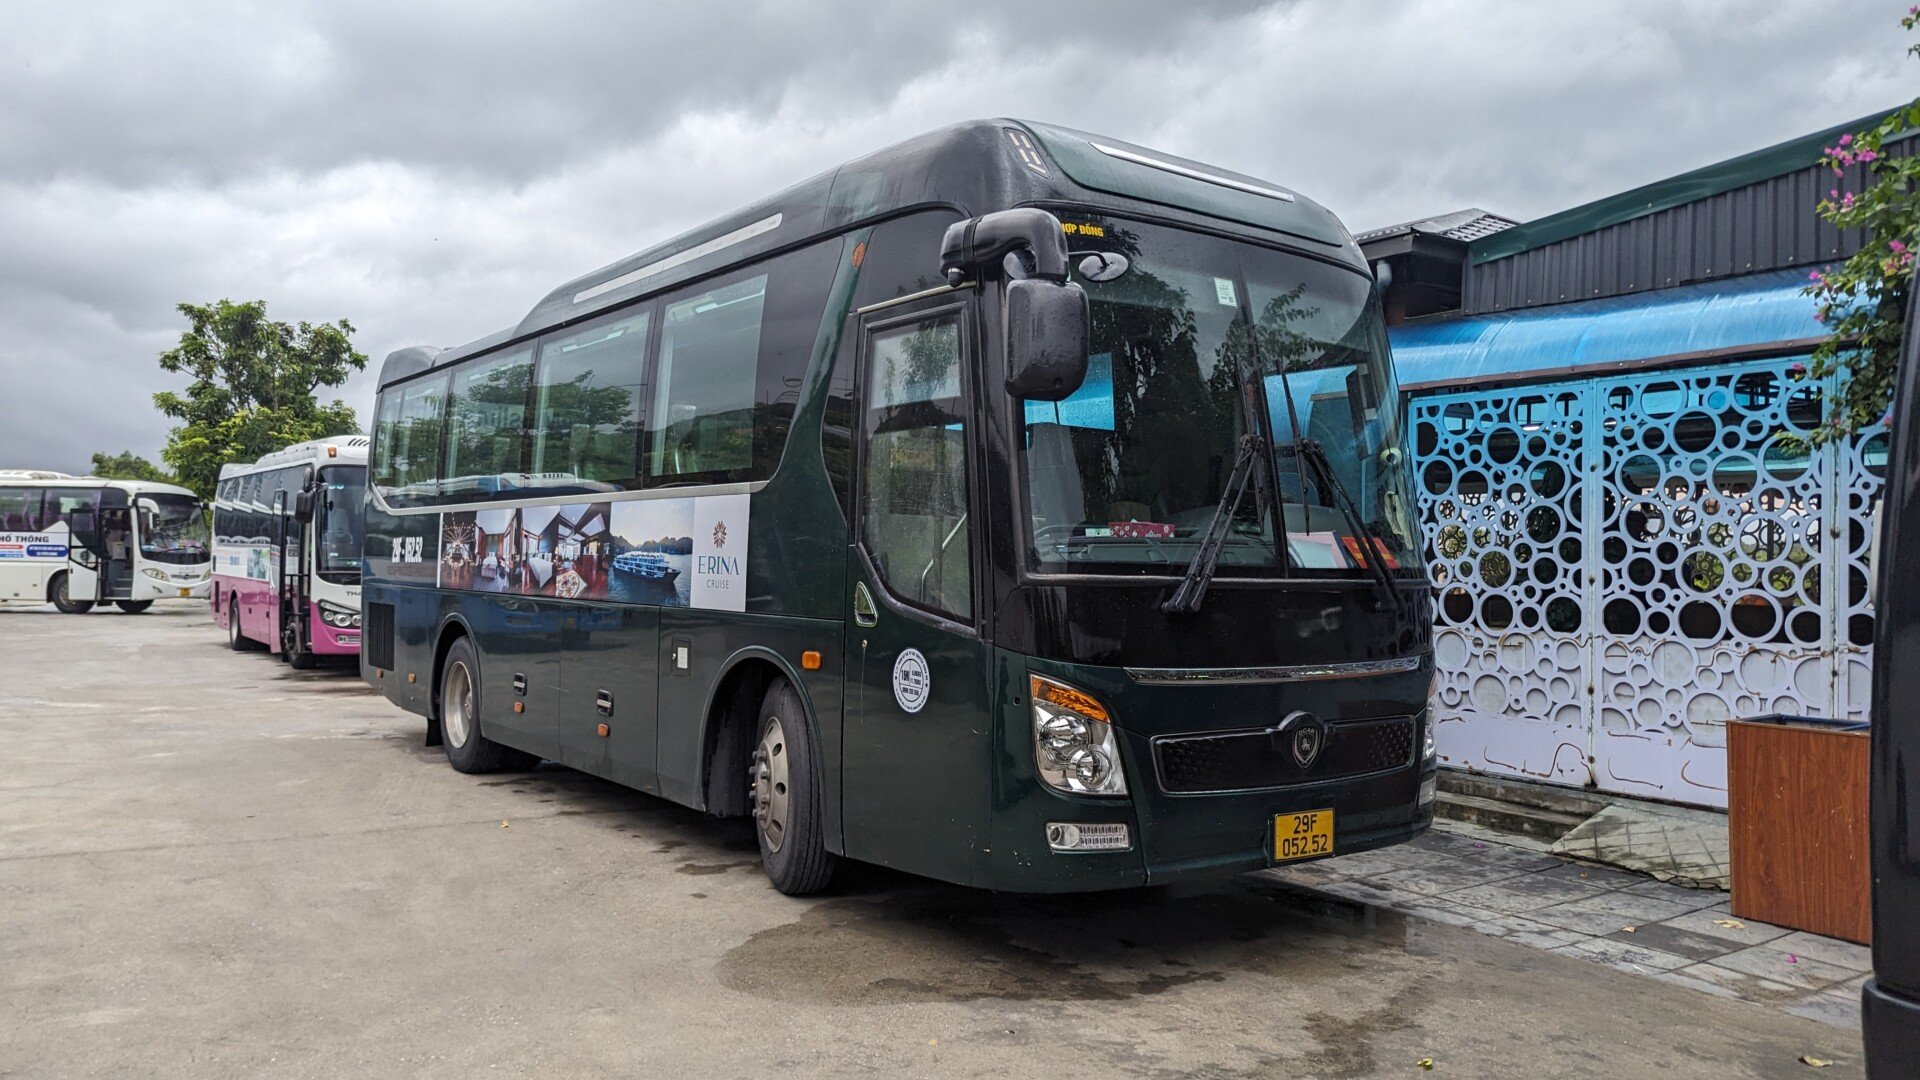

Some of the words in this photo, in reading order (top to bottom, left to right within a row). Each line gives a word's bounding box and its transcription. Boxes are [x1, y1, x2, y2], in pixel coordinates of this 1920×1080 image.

[15, 535, 49, 543] THÔNG
[698, 556, 739, 576] ERINA
[706, 579, 730, 590] CRUISE
[1293, 814, 1318, 835] 29F
[1282, 833, 1328, 857] 052.52
